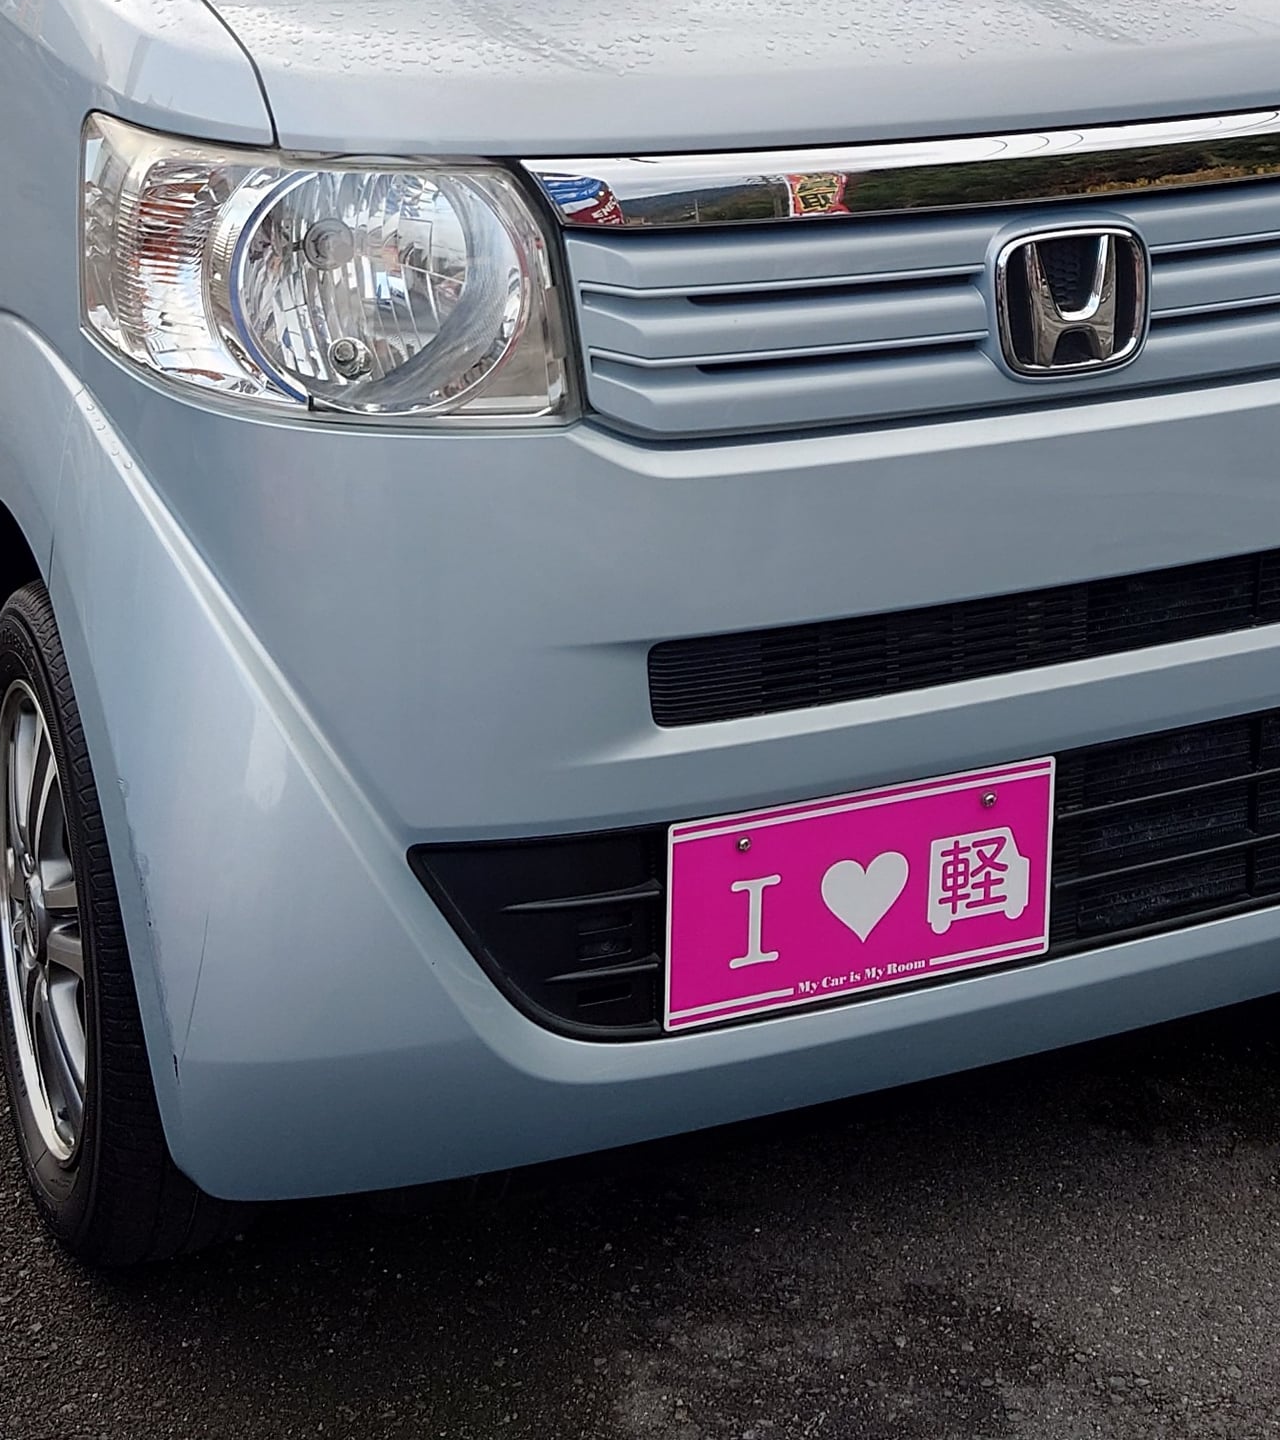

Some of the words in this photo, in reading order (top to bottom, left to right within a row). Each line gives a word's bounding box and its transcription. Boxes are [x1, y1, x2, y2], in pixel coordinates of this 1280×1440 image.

[729, 874, 781, 970] I
[938, 835, 1009, 915] 軽
[798, 980, 820, 994] My
[821, 975, 847, 989] Car
[849, 971, 862, 983] is
[864, 967, 886, 980] My
[886, 959, 927, 975] Room
